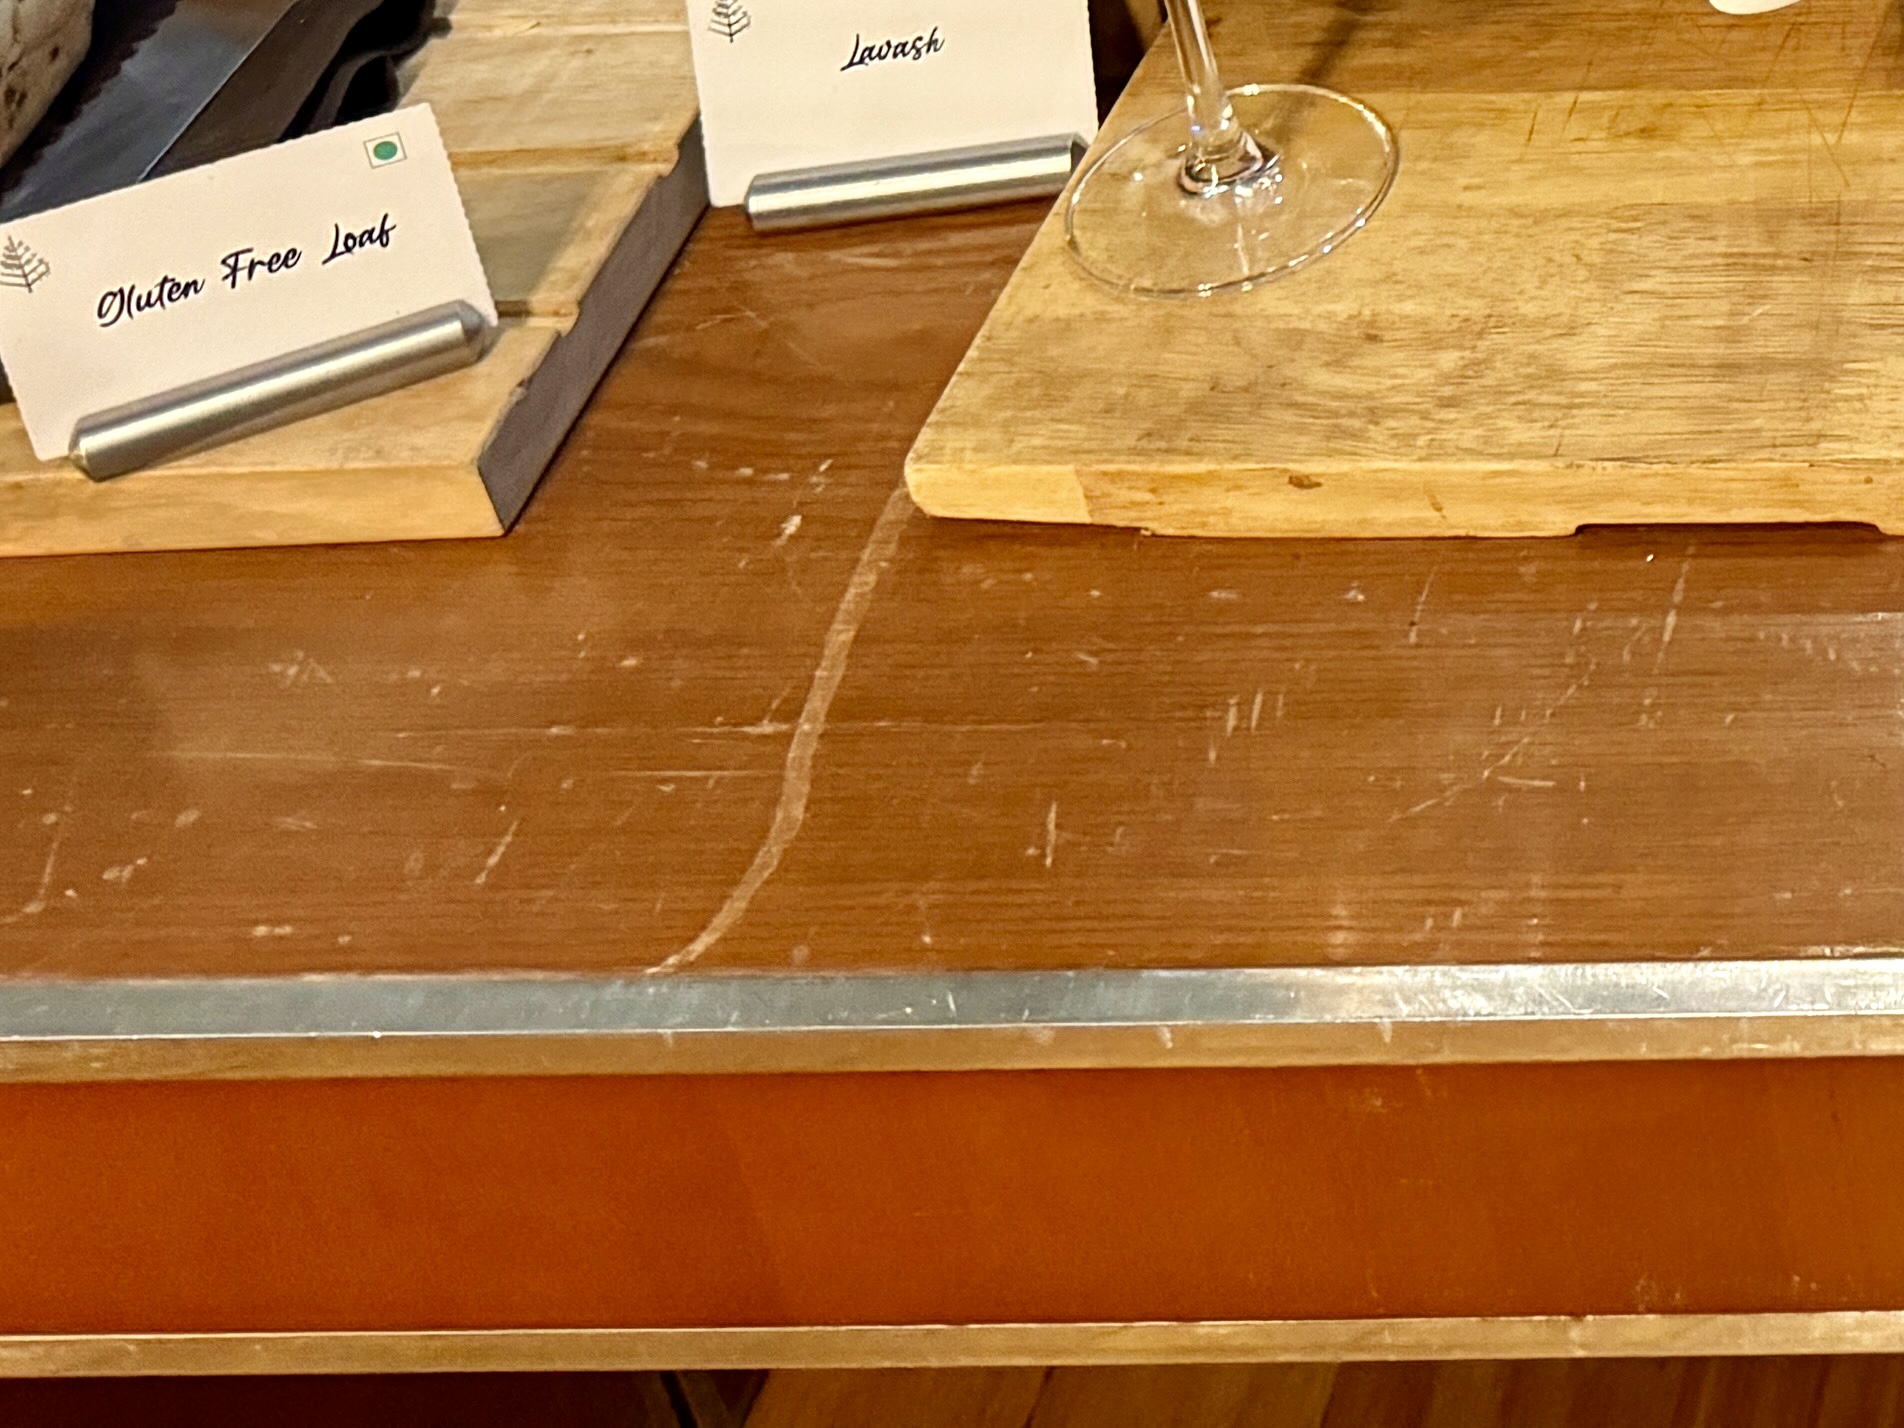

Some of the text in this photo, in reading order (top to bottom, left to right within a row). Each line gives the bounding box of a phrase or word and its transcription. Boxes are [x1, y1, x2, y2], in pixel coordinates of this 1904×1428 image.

[839, 25, 946, 72] Lavash
[96, 212, 397, 328] Gluten Free Loaf
